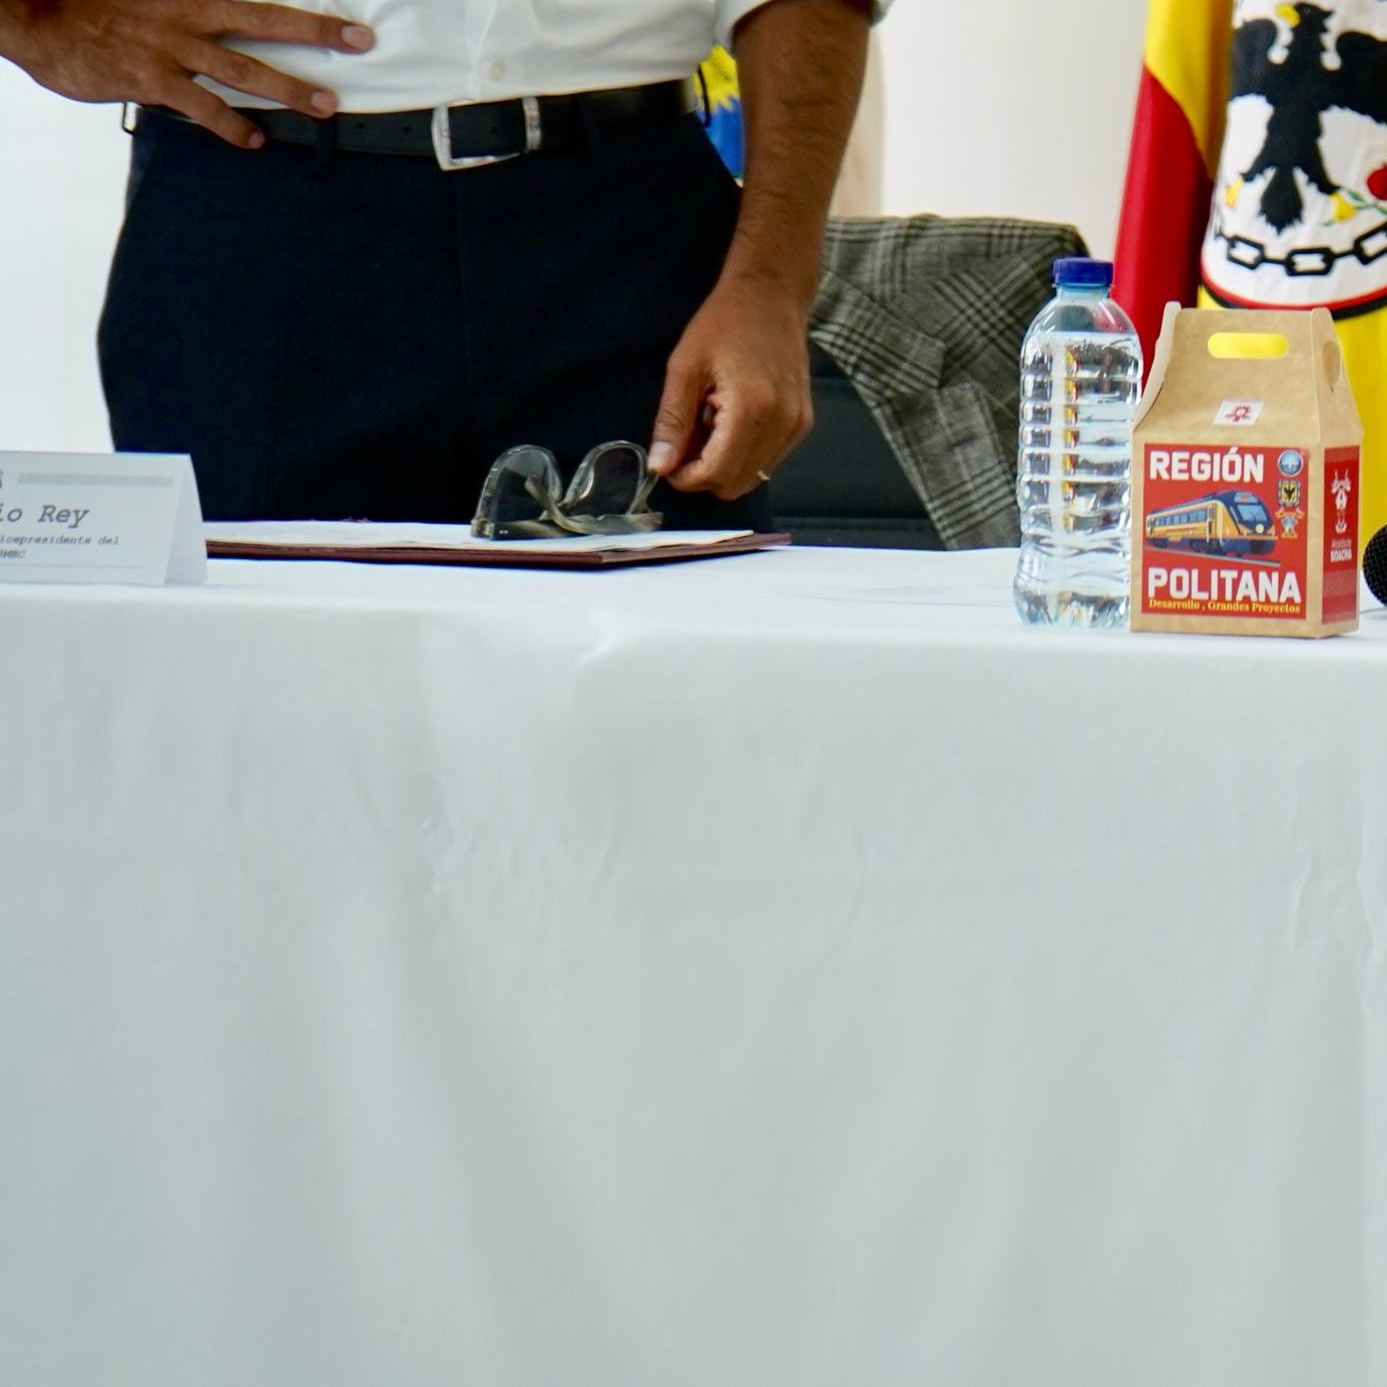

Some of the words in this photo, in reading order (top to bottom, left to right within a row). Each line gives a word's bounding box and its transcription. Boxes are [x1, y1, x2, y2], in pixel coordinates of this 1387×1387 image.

[1149, 446, 1265, 483] REGIÓN
[37, 504, 90, 529] Rey
[97, 535, 120, 545] del
[1147, 567, 1302, 603] POLITANA
[1149, 598, 1200, 610] Desarrollo
[1207, 600, 1250, 612] Grandes
[1251, 601, 1301, 614] Proyectos
